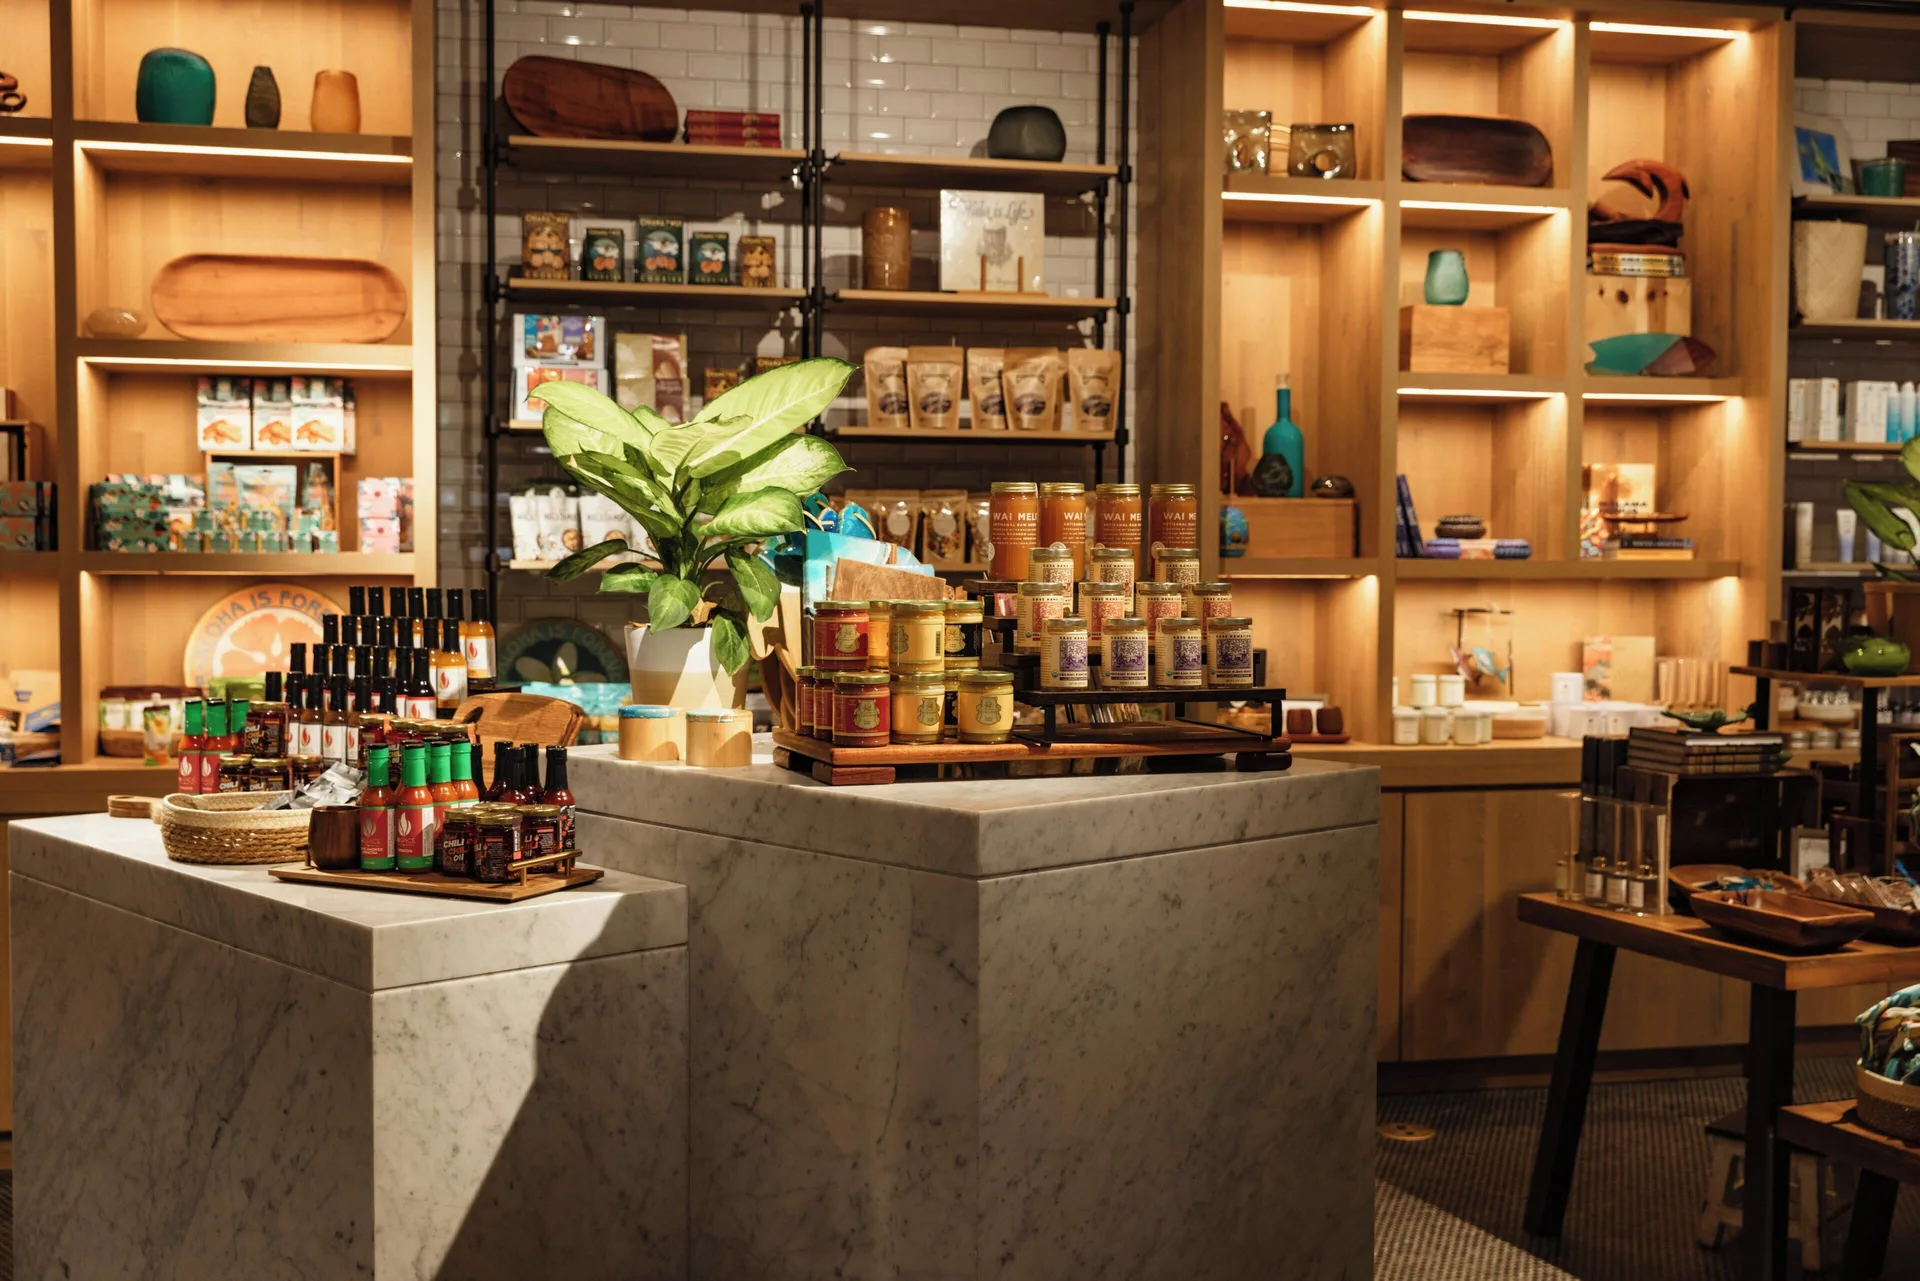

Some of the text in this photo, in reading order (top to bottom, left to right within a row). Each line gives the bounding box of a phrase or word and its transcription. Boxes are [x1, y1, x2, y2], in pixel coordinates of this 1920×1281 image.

[992, 512, 1013, 521] WAI
[1063, 512, 1083, 520] WAI
[1103, 512, 1142, 521] WAI ME
[1163, 512, 1197, 520] WAI ME
[250, 590, 272, 609] IS
[279, 590, 335, 620] FORE
[245, 724, 261, 733] CHILI
[219, 780, 239, 790] CHILI
[250, 781, 264, 790] CHILI
[443, 838, 465, 848] CHILI
